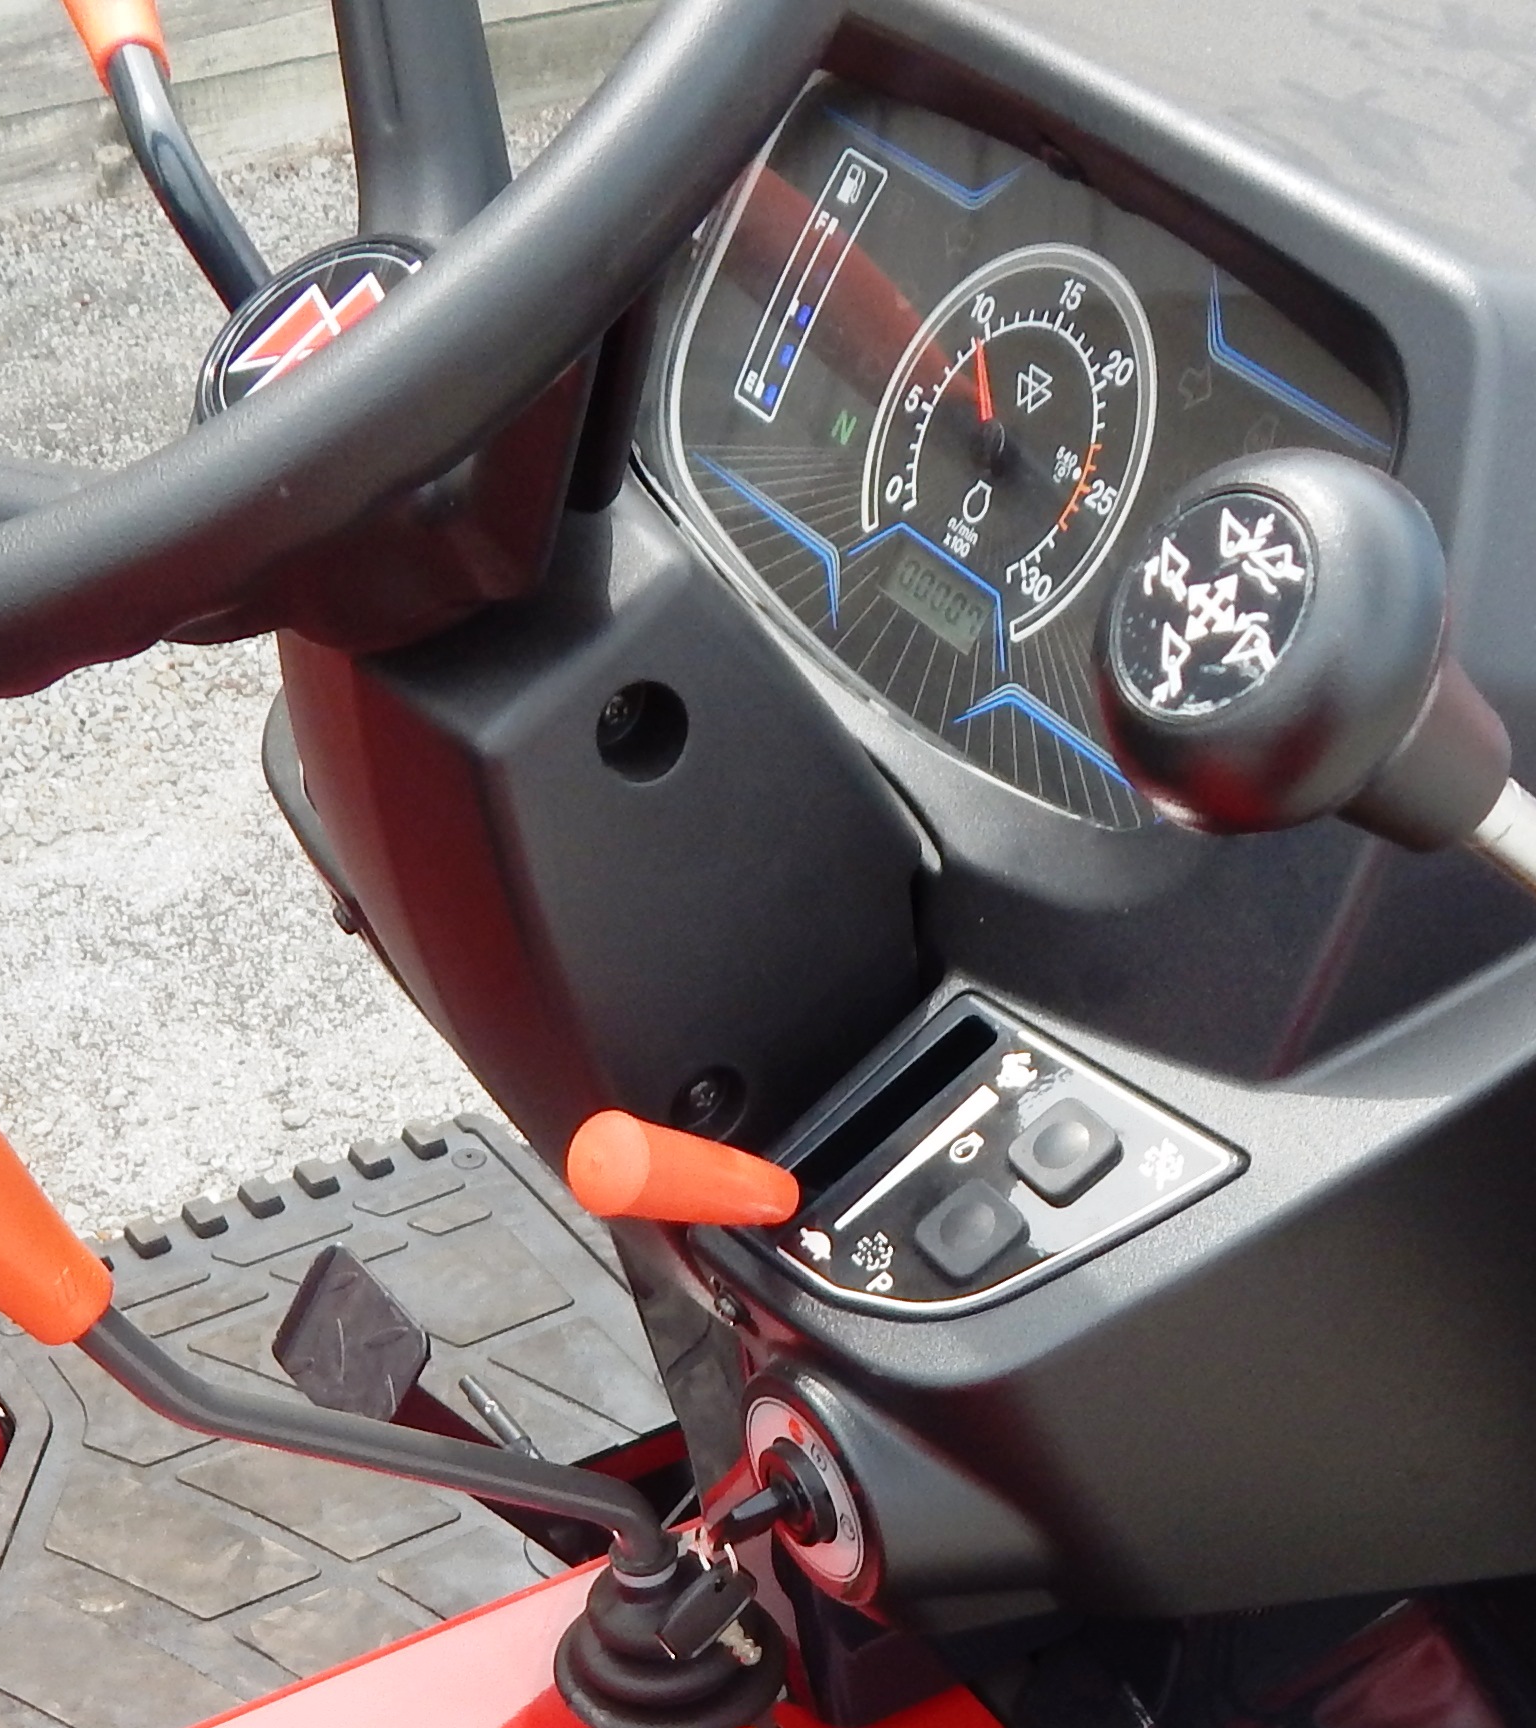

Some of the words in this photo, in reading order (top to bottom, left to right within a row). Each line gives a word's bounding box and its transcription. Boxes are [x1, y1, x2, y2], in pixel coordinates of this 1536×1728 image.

[815, 210, 830, 229] F
[970, 292, 996, 324] 10
[1059, 278, 1087, 311] 15
[744, 369, 759, 393] E
[1101, 349, 1134, 387] 20
[904, 384, 924, 413] 5
[831, 408, 857, 446] N
[885, 475, 904, 503] 0
[1084, 479, 1117, 516] 25
[942, 532, 971, 558] x100
[1021, 566, 1052, 603] 30
[866, 1270, 894, 1292] P
